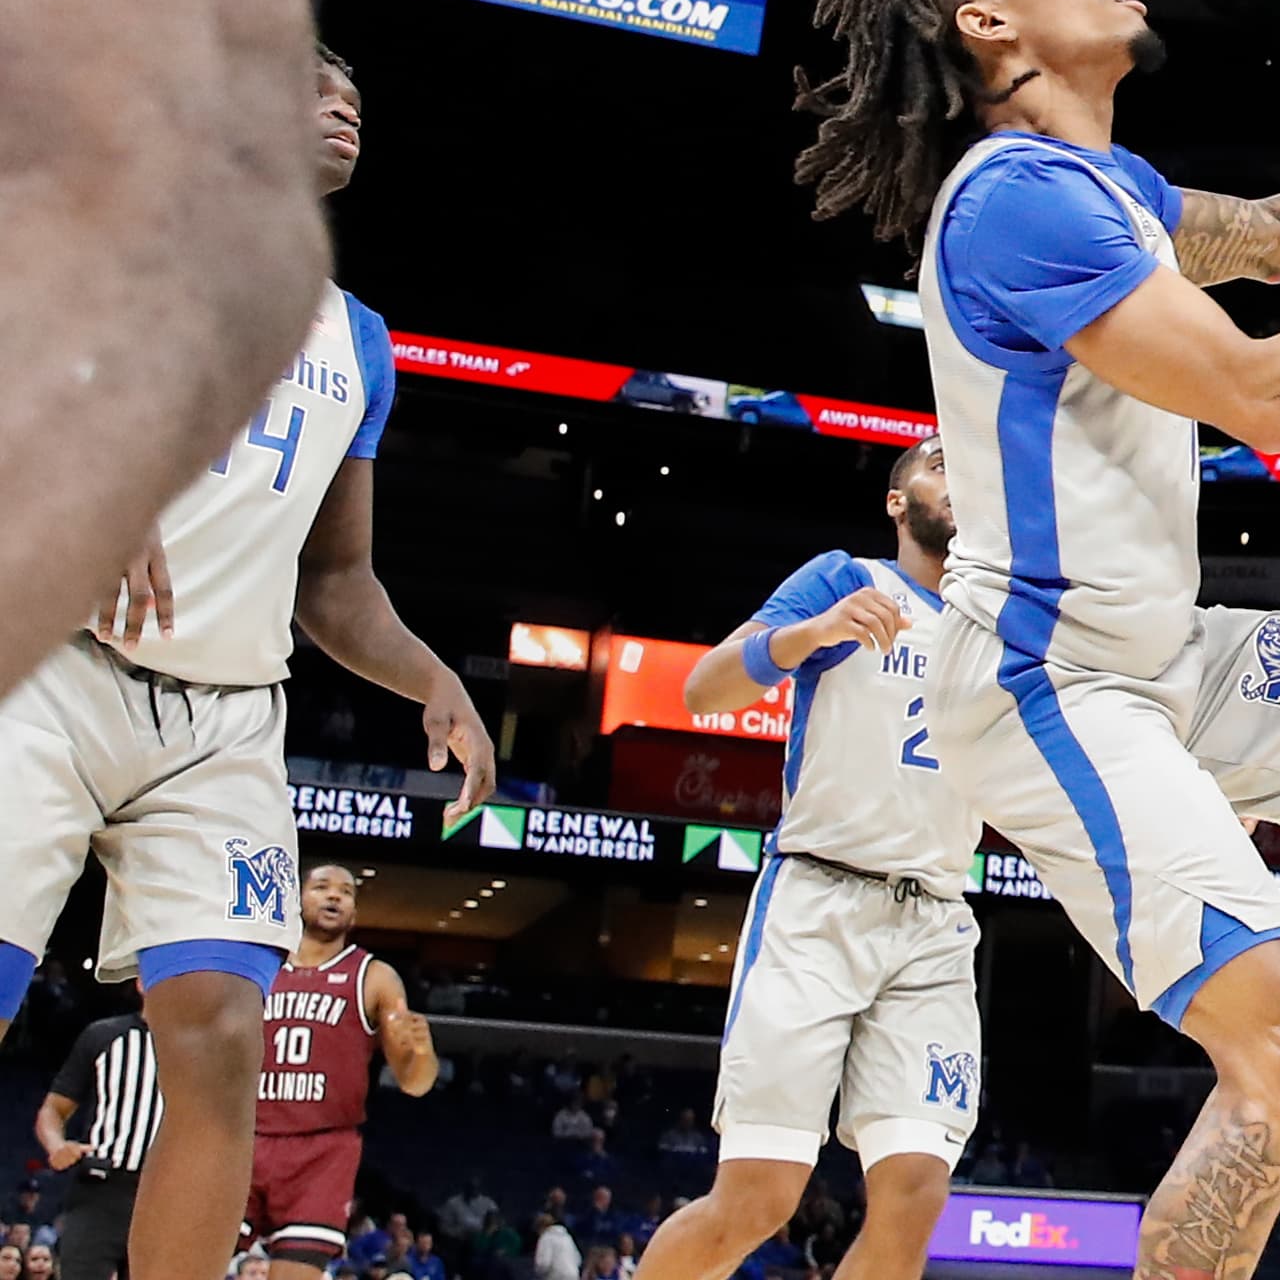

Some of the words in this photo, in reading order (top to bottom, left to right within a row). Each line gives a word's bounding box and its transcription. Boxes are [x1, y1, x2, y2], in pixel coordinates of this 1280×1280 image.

[627, 14, 716, 41] HANDLING
[450, 351, 499, 373] THAN
[819, 408, 859, 429] AWD
[860, 415, 933, 438] VEHICLES
[287, 784, 412, 819] RENEWAL
[298, 812, 411, 838] ANDERSEN
[528, 809, 655, 843] RENEWAL
[544, 838, 655, 862] ANDERSEN
[263, 991, 347, 1027] OUTHERN
[273, 1026, 312, 1065] 10
[969, 1209, 1070, 1249] FedEx
